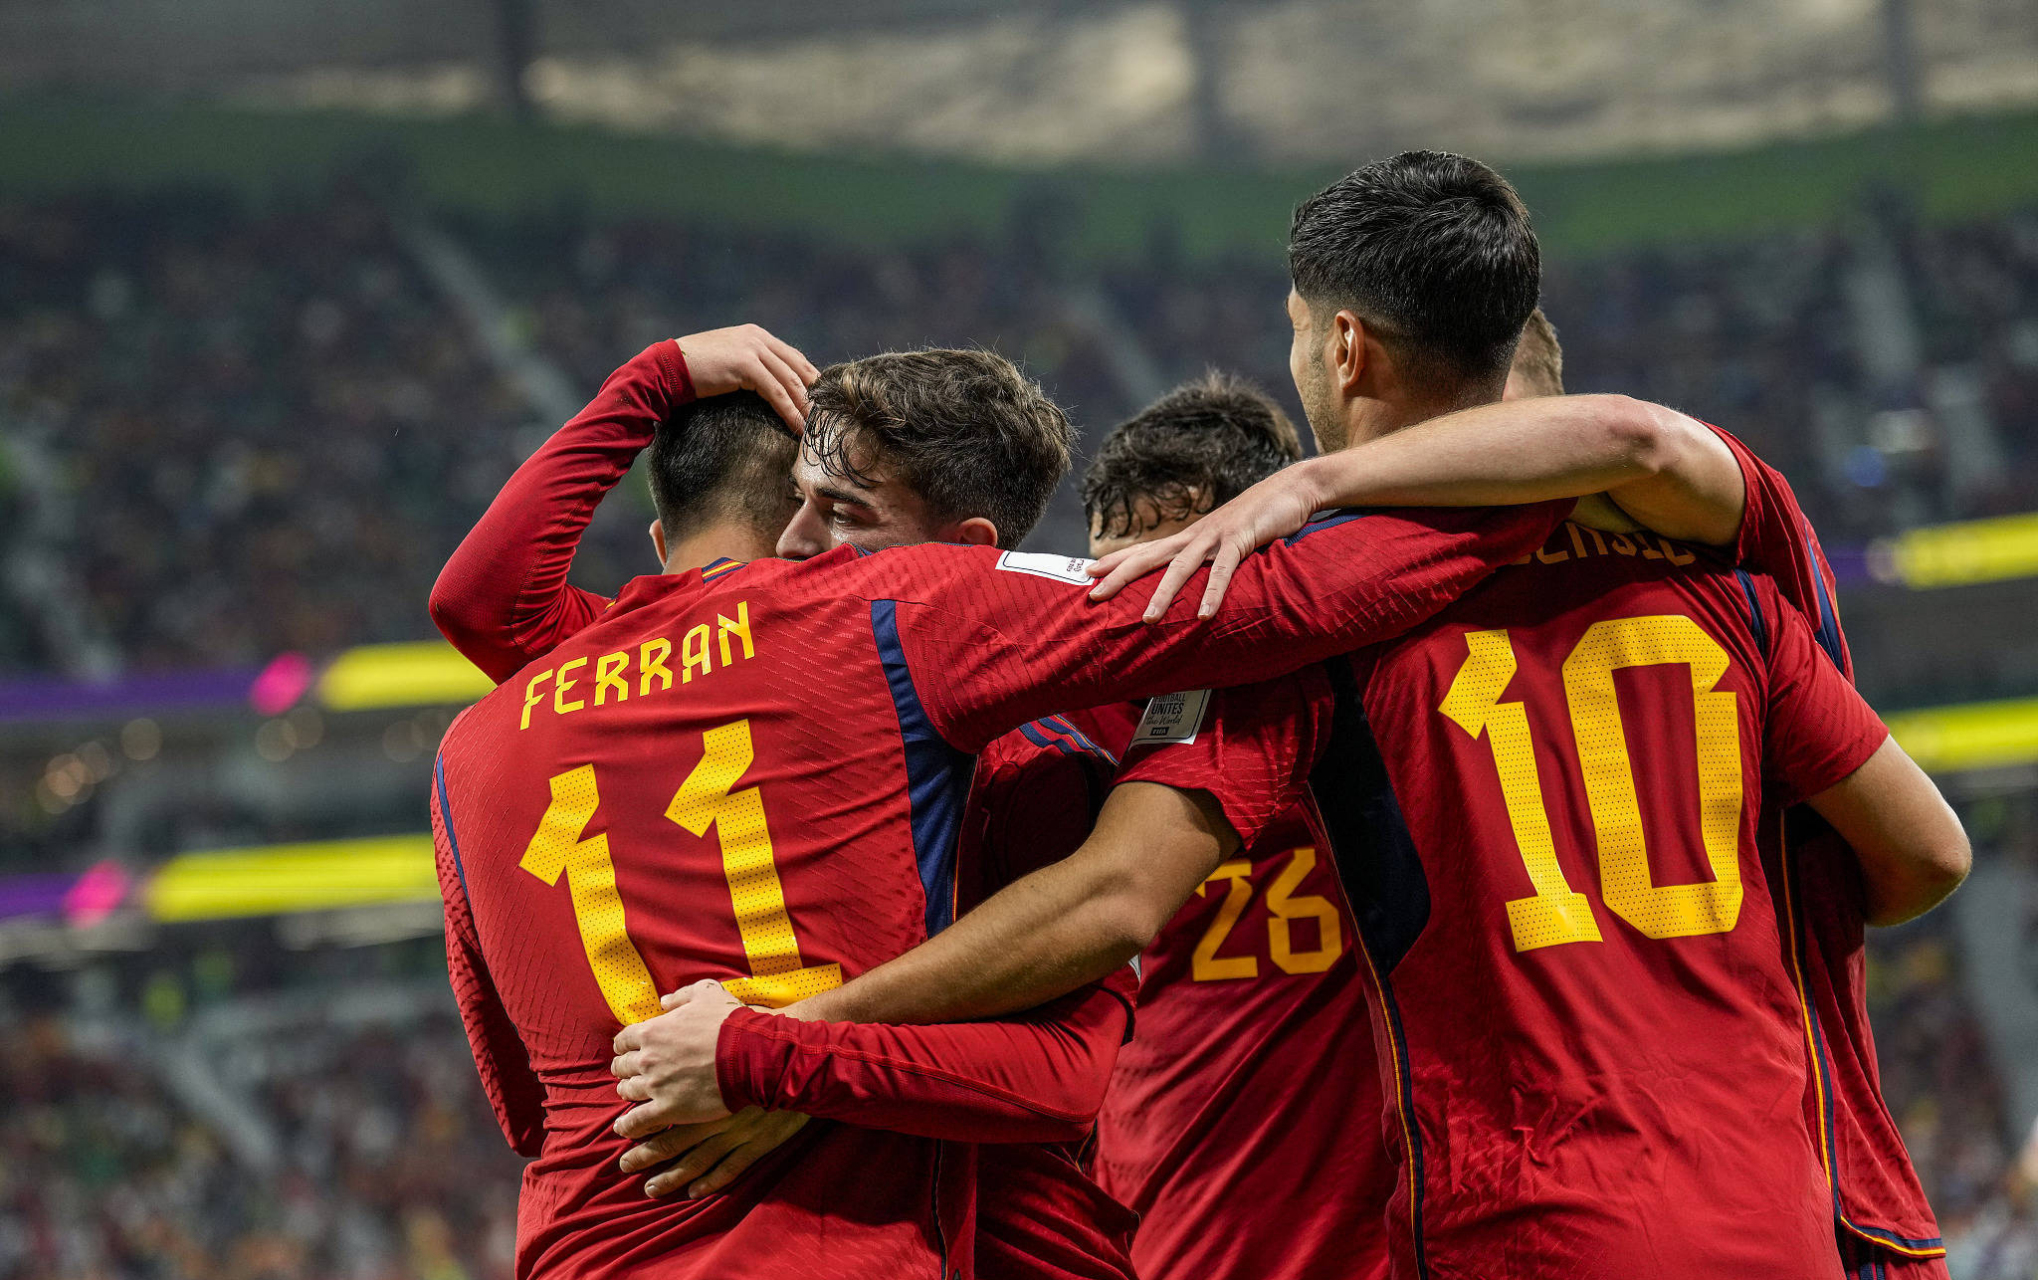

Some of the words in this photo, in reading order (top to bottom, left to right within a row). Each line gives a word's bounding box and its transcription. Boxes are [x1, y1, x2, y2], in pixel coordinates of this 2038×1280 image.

[520, 601, 755, 730] FERRAN
[1151, 703, 1184, 715] UNITES
[1438, 615, 1744, 952] 10
[519, 718, 843, 1026] 11
[1195, 848, 1342, 982] 26
